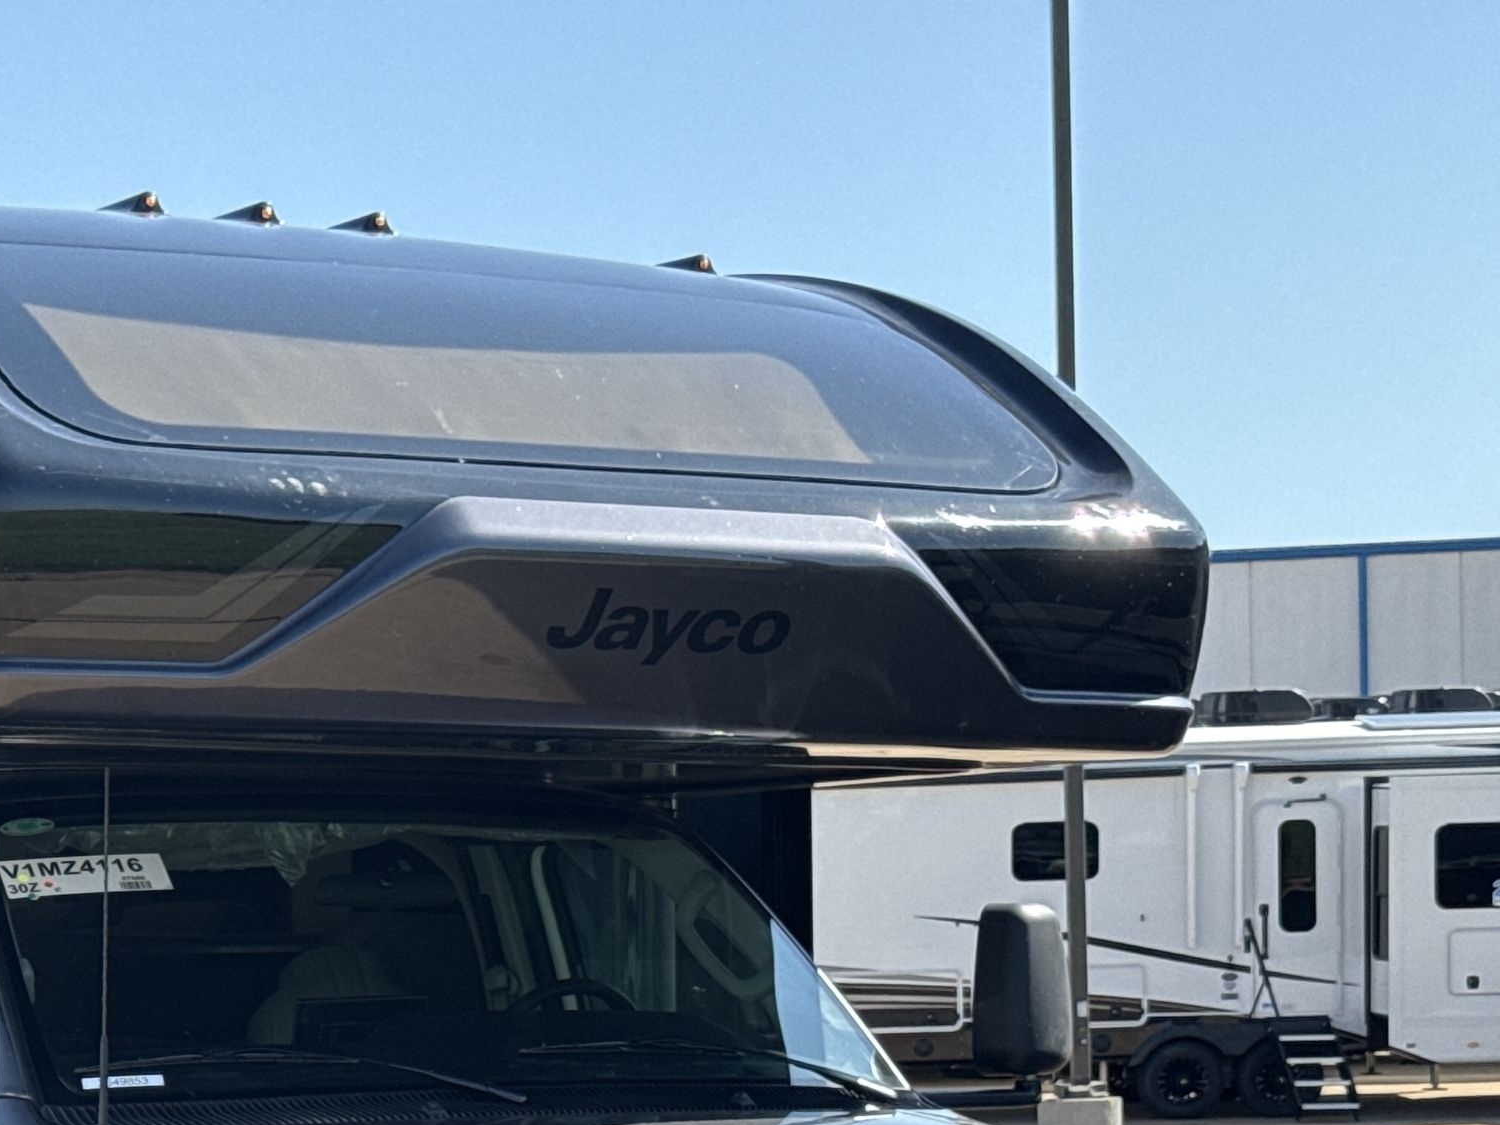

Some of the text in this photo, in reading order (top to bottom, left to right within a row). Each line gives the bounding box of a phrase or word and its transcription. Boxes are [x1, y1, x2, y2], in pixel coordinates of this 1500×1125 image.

[546, 587, 792, 667] Jayco
[1, 857, 143, 879] V1MZ4116
[7, 882, 41, 895] 30Z
